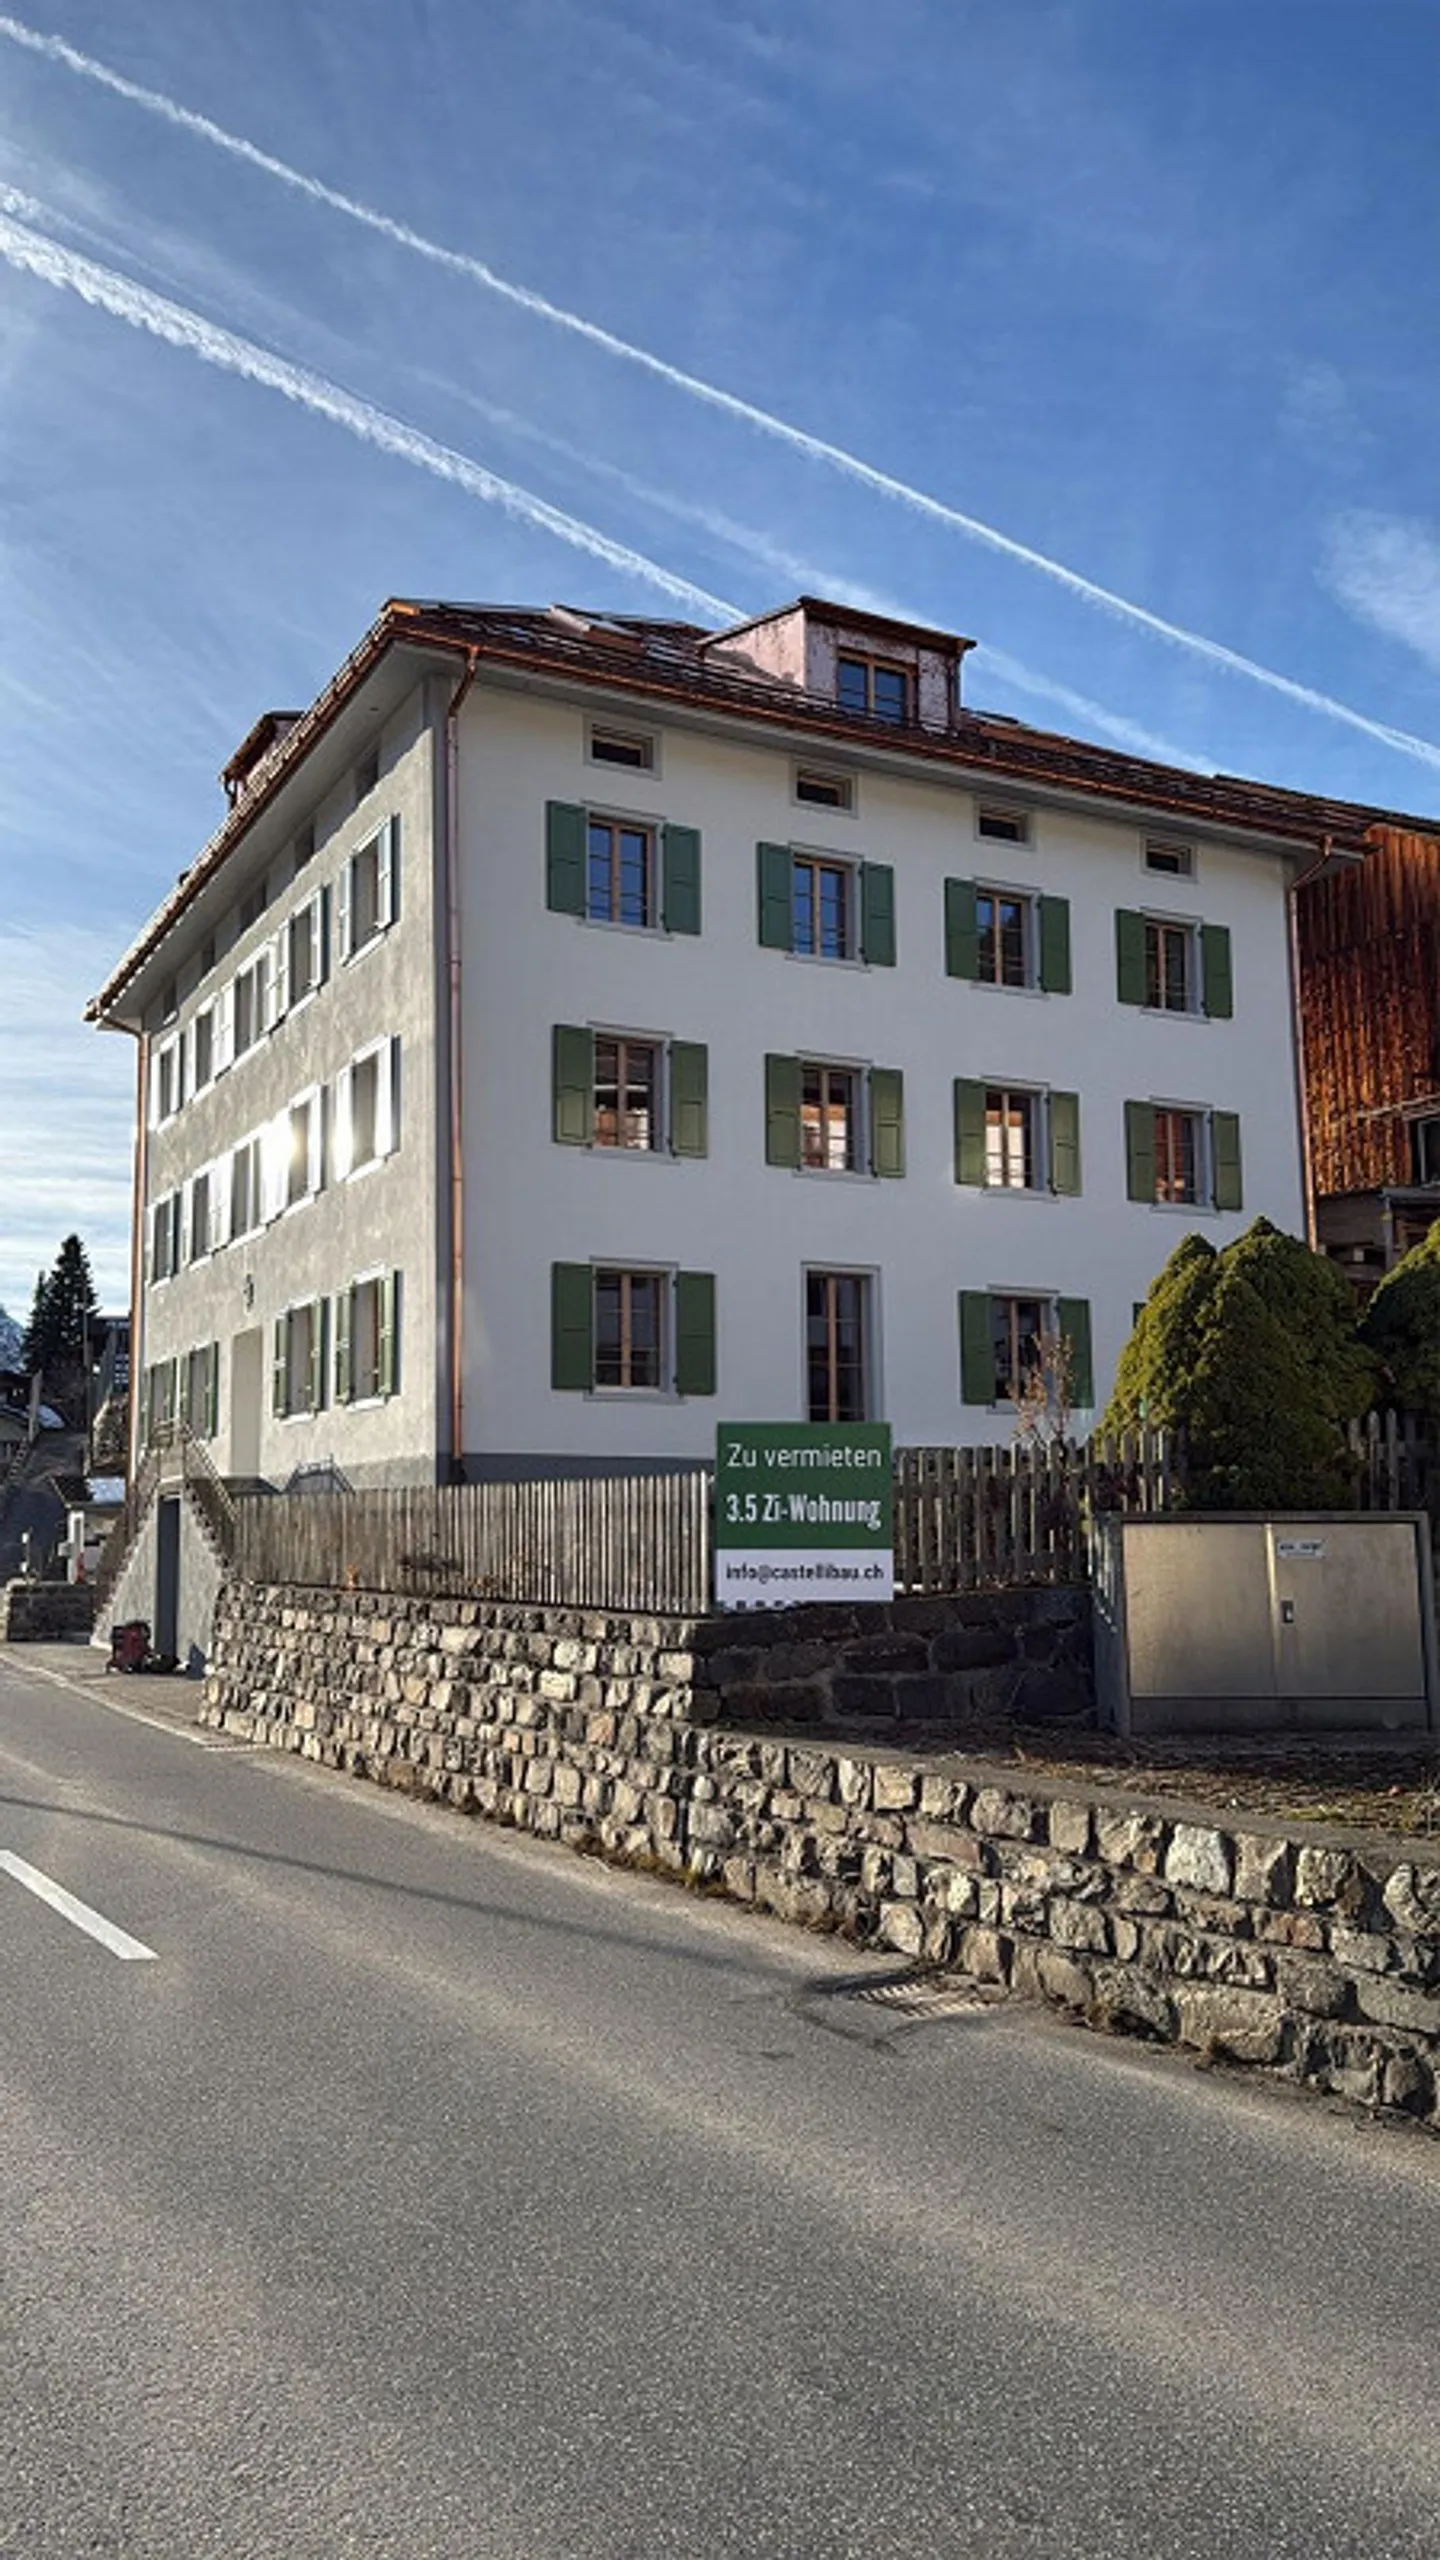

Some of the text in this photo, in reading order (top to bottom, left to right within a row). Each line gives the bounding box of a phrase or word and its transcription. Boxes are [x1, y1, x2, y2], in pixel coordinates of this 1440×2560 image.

[727, 1443, 881, 1467] Zu vermieten
[726, 1562, 884, 1584] info@castellibau.ch
